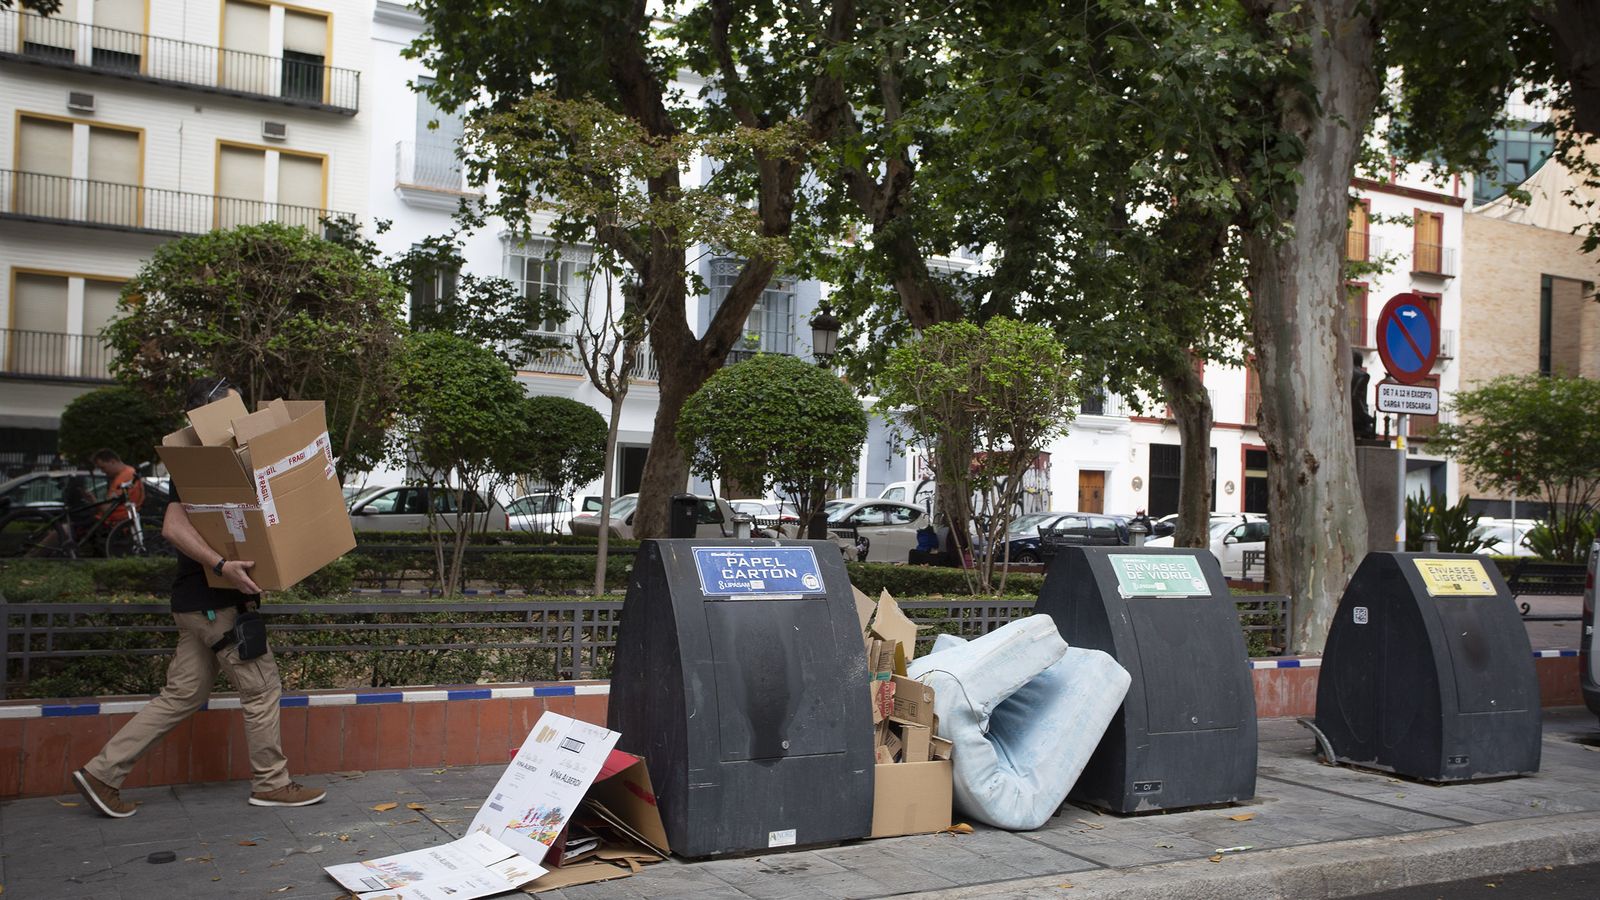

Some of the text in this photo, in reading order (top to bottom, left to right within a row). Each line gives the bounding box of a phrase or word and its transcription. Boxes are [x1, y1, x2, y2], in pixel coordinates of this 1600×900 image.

[1383, 388, 1390, 396] DE
[1411, 391, 1432, 399] EXCEPTO
[1384, 400, 1400, 408] CARGA
[1406, 402, 1431, 410] DESCARGA
[258, 475, 270, 502] FRAGIL
[726, 557, 786, 567] PAPEL
[721, 565, 798, 579] CARTÓN
[1126, 563, 1187, 572] ENVASES
[1127, 571, 1192, 580] DE VIDRIO
[1433, 574, 1478, 582] LIGEROS
